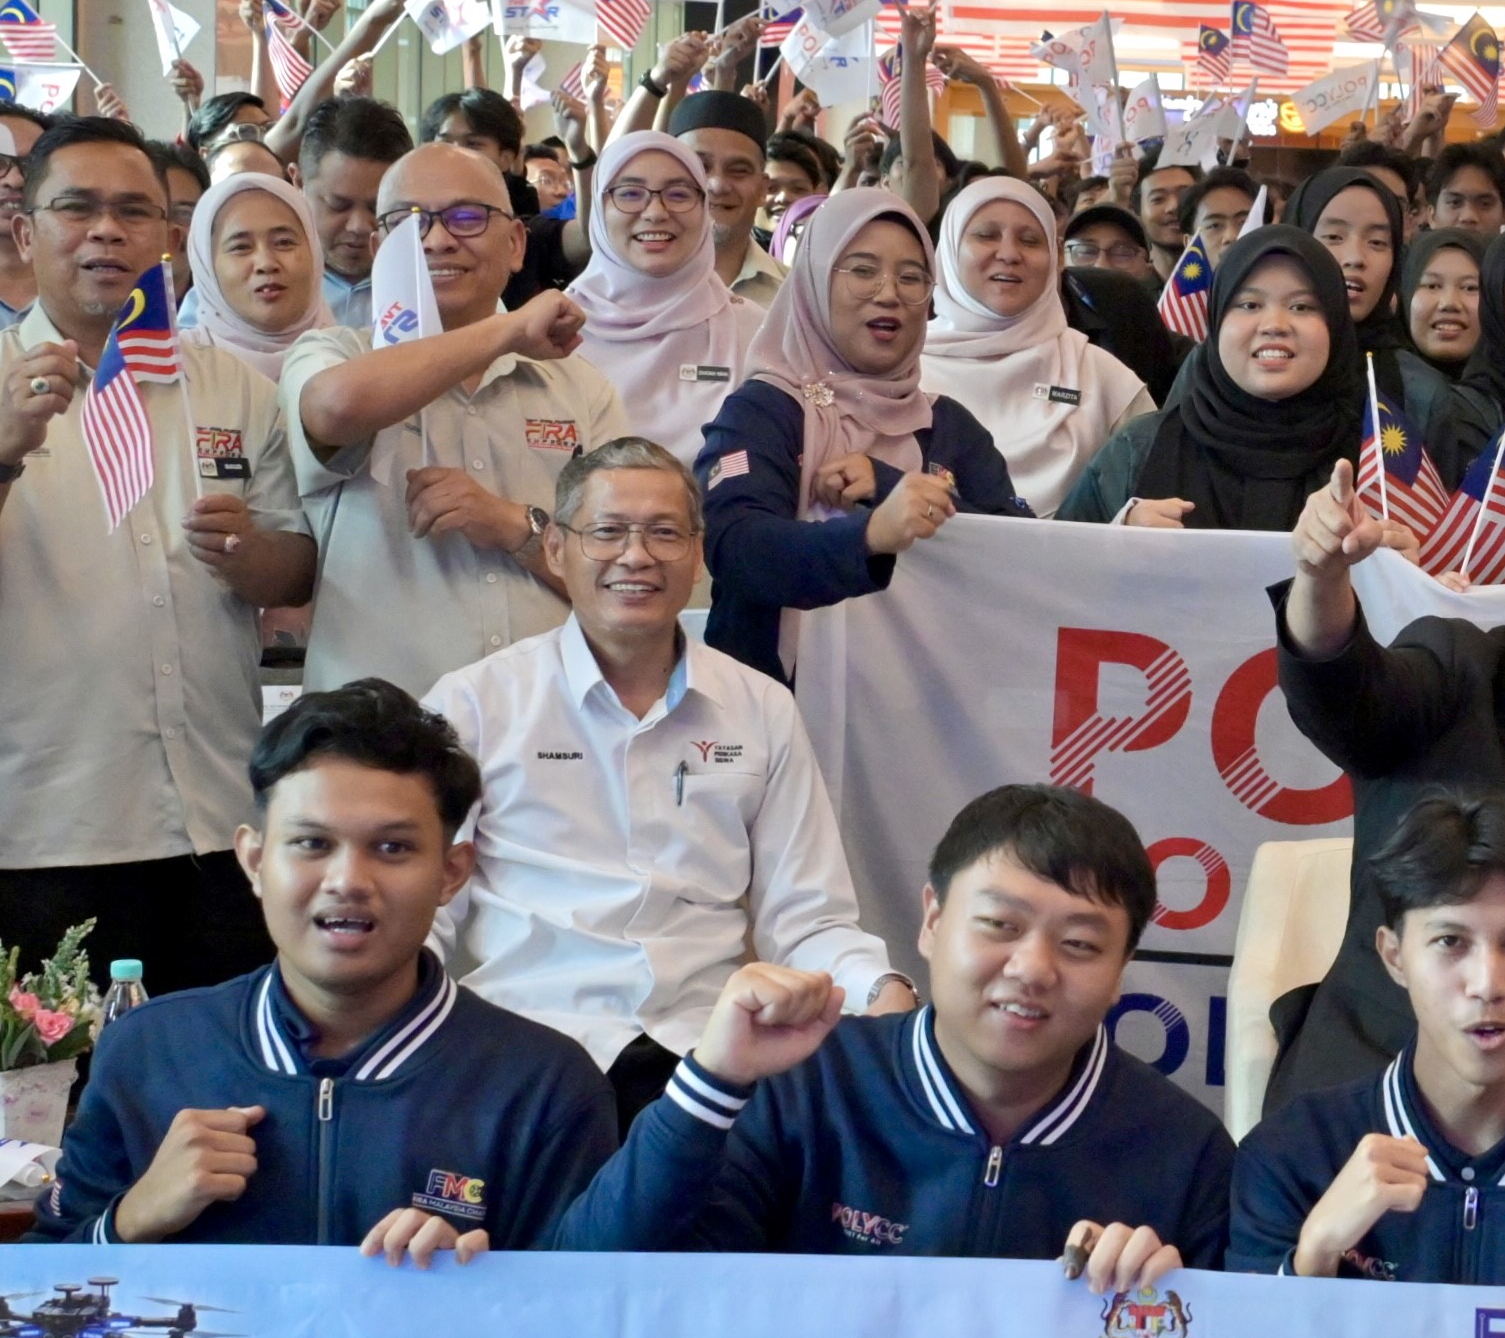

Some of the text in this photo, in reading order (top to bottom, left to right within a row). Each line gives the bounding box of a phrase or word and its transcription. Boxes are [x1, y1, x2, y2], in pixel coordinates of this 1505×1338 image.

[525, 421, 577, 443] FIRA
[537, 751, 583, 760] SHAMSURI
[425, 1168, 485, 1203] FMC
